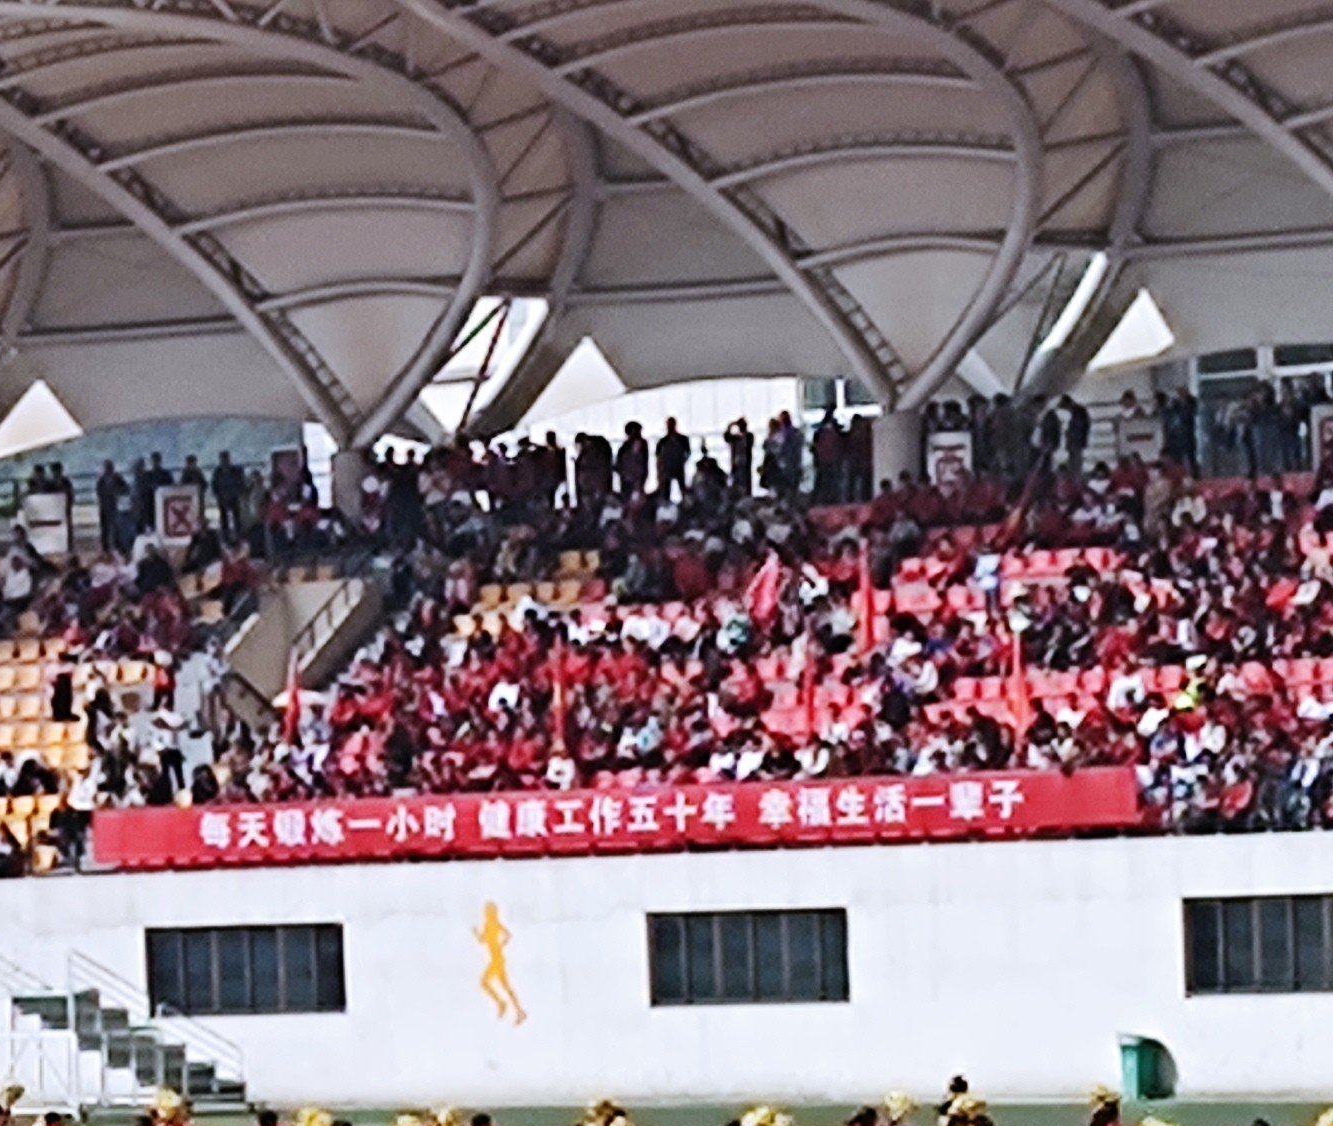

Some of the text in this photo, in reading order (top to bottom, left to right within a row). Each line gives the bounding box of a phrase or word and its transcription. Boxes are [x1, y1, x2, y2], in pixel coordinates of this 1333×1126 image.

[199, 779, 1025, 849] 每天锻炼一小时 健康工作五十年 幸福生活一辈子
